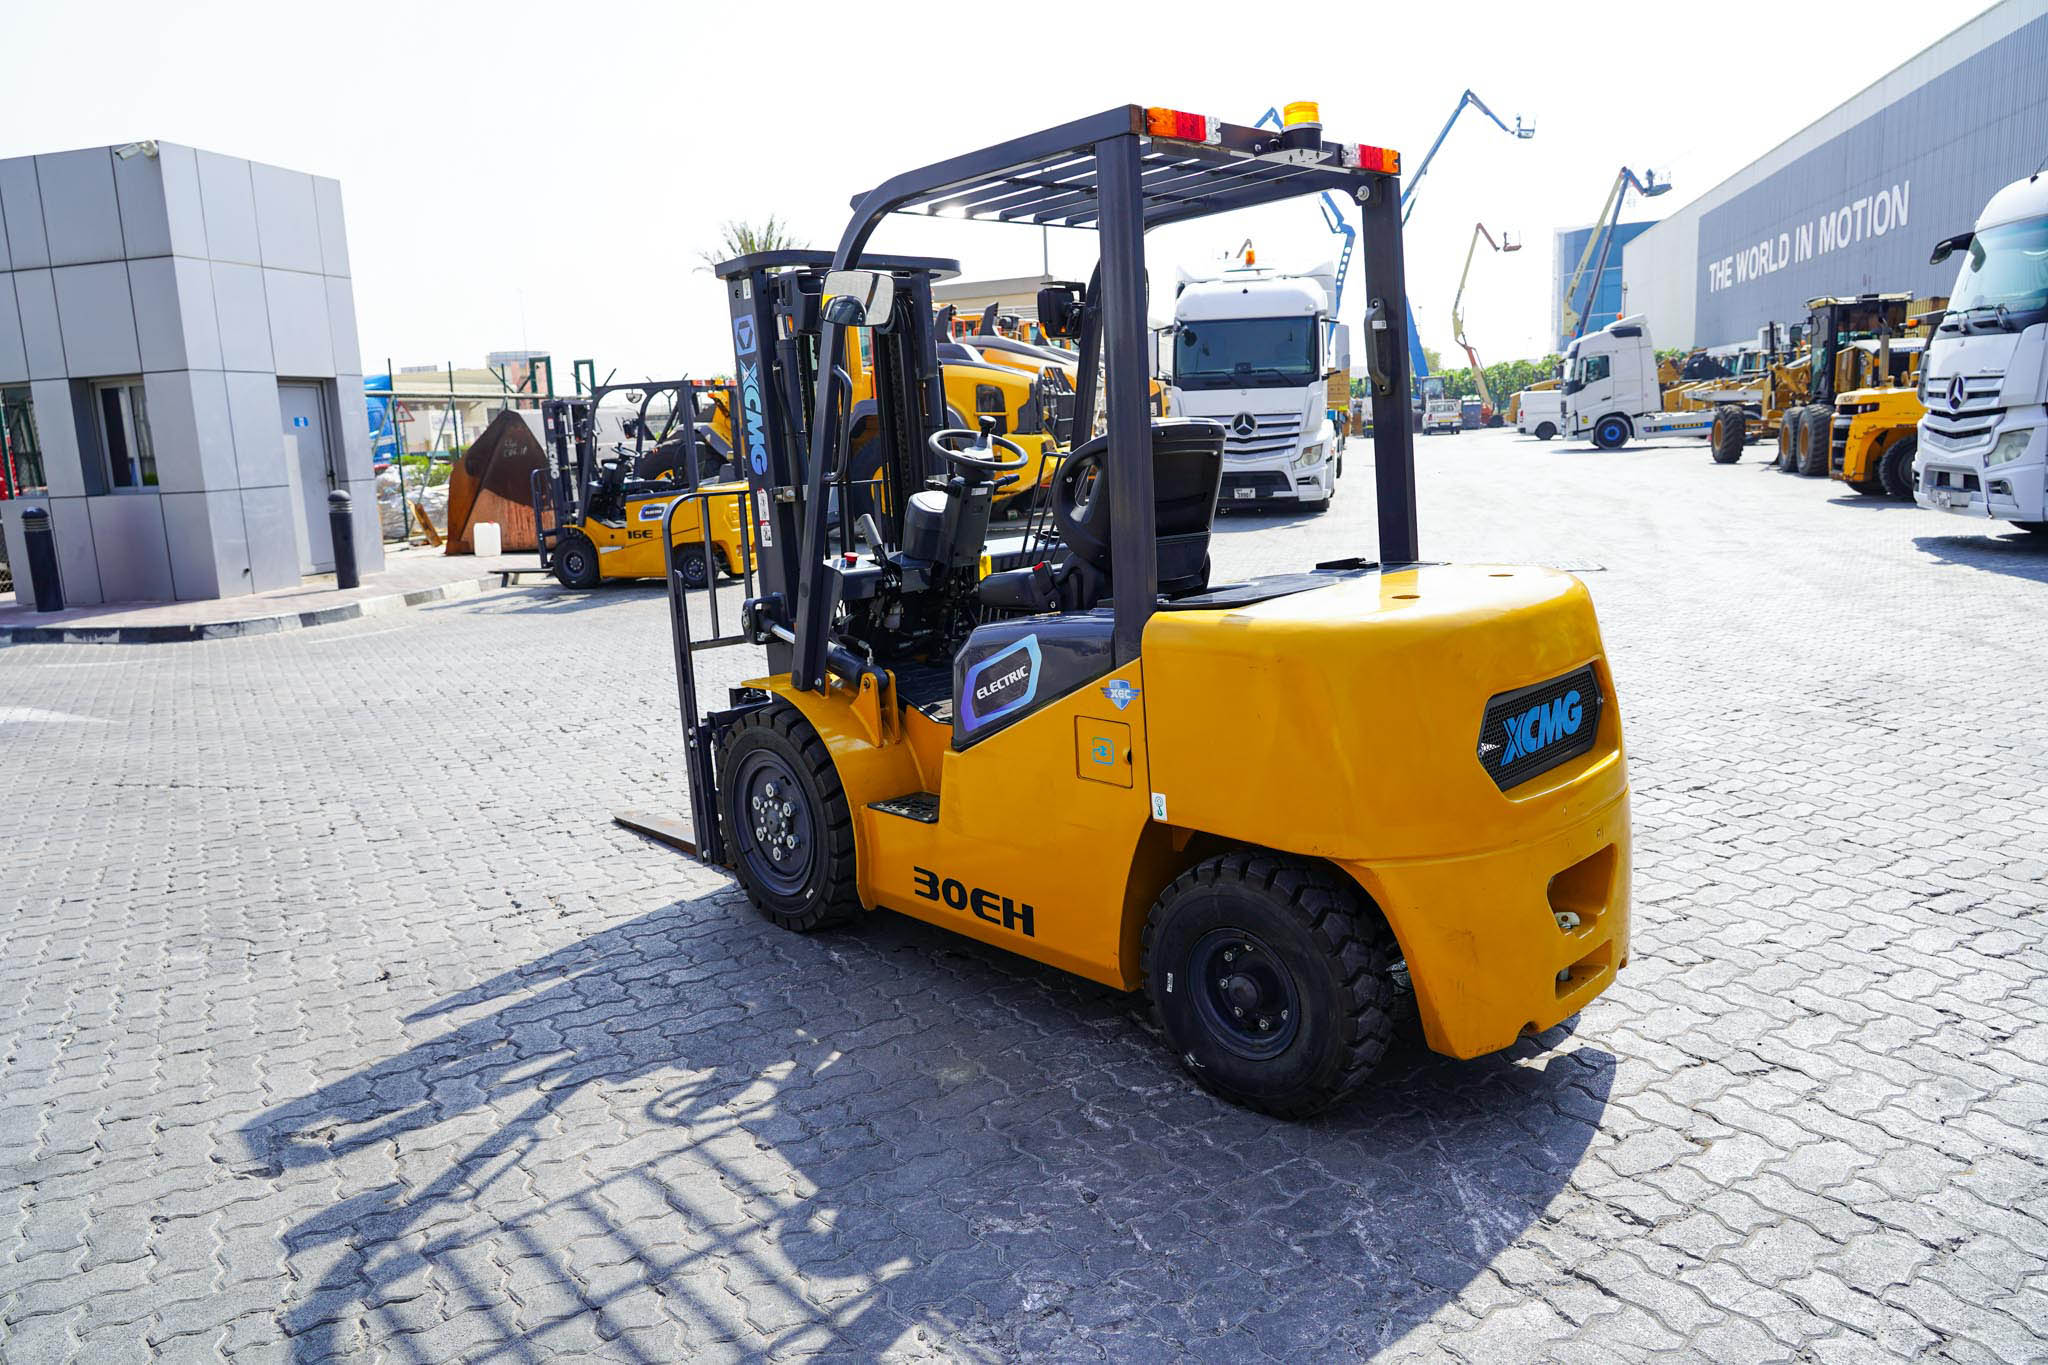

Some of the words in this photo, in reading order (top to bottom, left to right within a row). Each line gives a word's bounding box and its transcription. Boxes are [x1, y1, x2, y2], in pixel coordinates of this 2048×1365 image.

[1709, 256, 1733, 293] THE
[1736, 232, 1790, 284] WORLD
[1795, 221, 1814, 263] IN
[1818, 180, 1910, 255] MOTION
[739, 358, 768, 476] XCMG
[547, 441, 560, 479] XCMG
[627, 529, 654, 539] 16E
[976, 665, 1029, 700] ELECTRIC
[1500, 690, 1583, 767] XCMG
[913, 866, 1035, 938] 30EH
